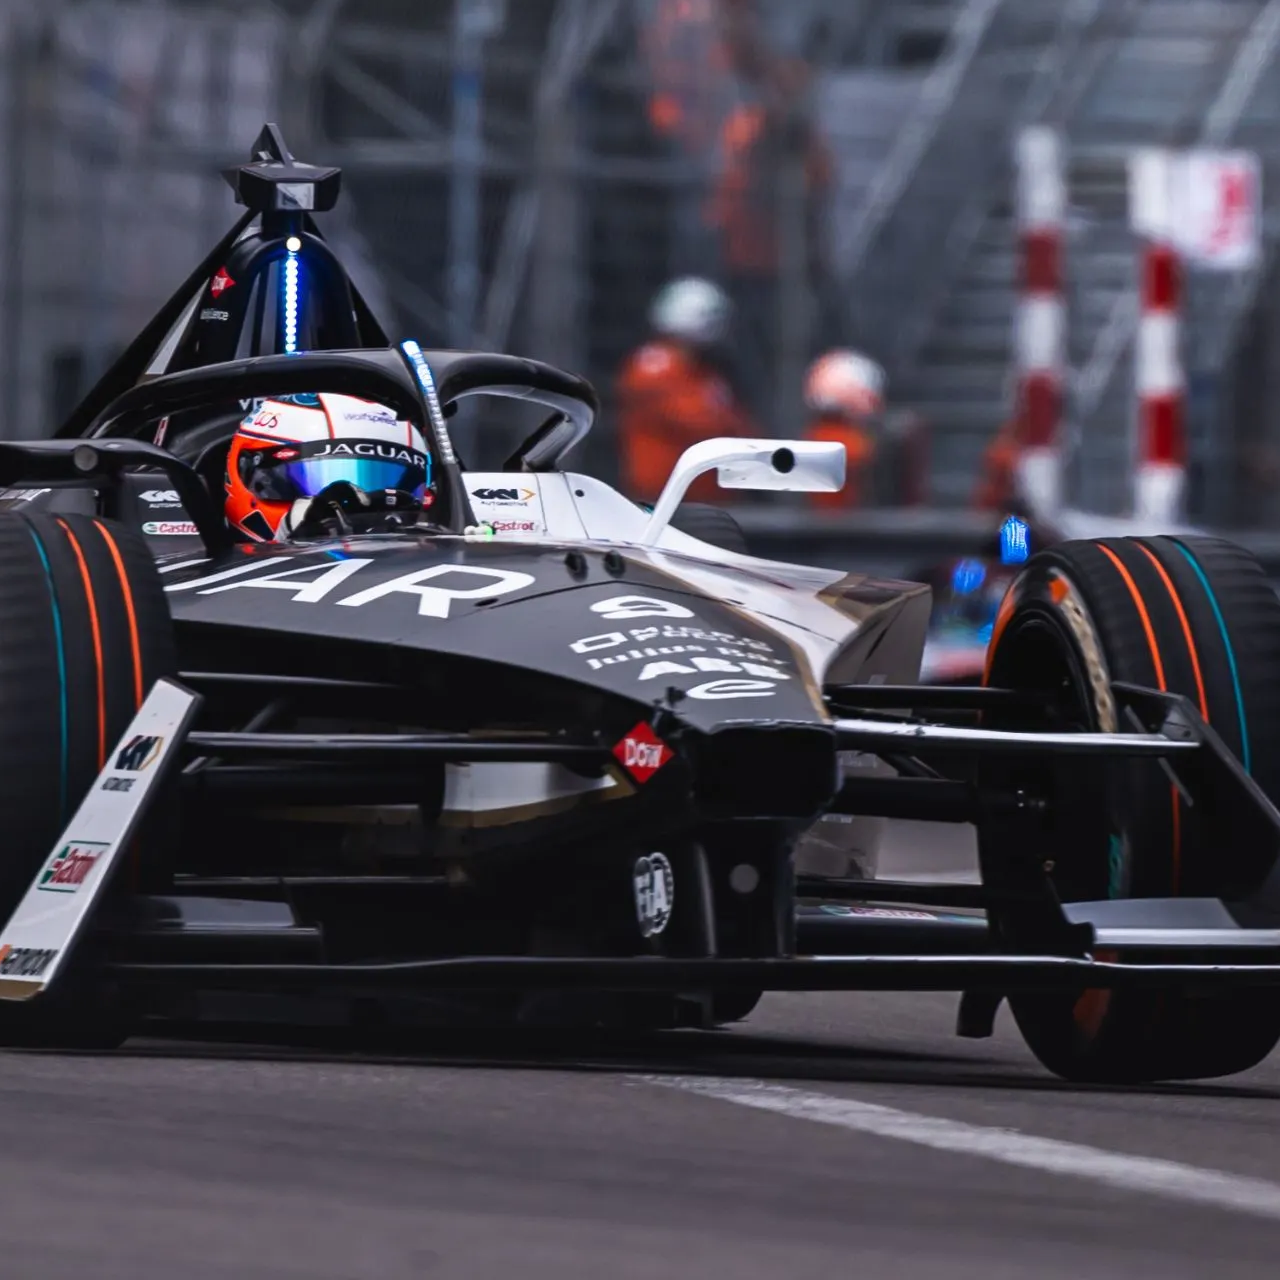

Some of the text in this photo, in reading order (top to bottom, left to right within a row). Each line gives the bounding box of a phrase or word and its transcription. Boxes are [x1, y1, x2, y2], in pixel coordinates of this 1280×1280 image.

[314, 443, 425, 470] JAGUAR
[472, 488, 519, 500] GKN
[160, 523, 198, 533] Castro
[638, 657, 792, 681] ABB
